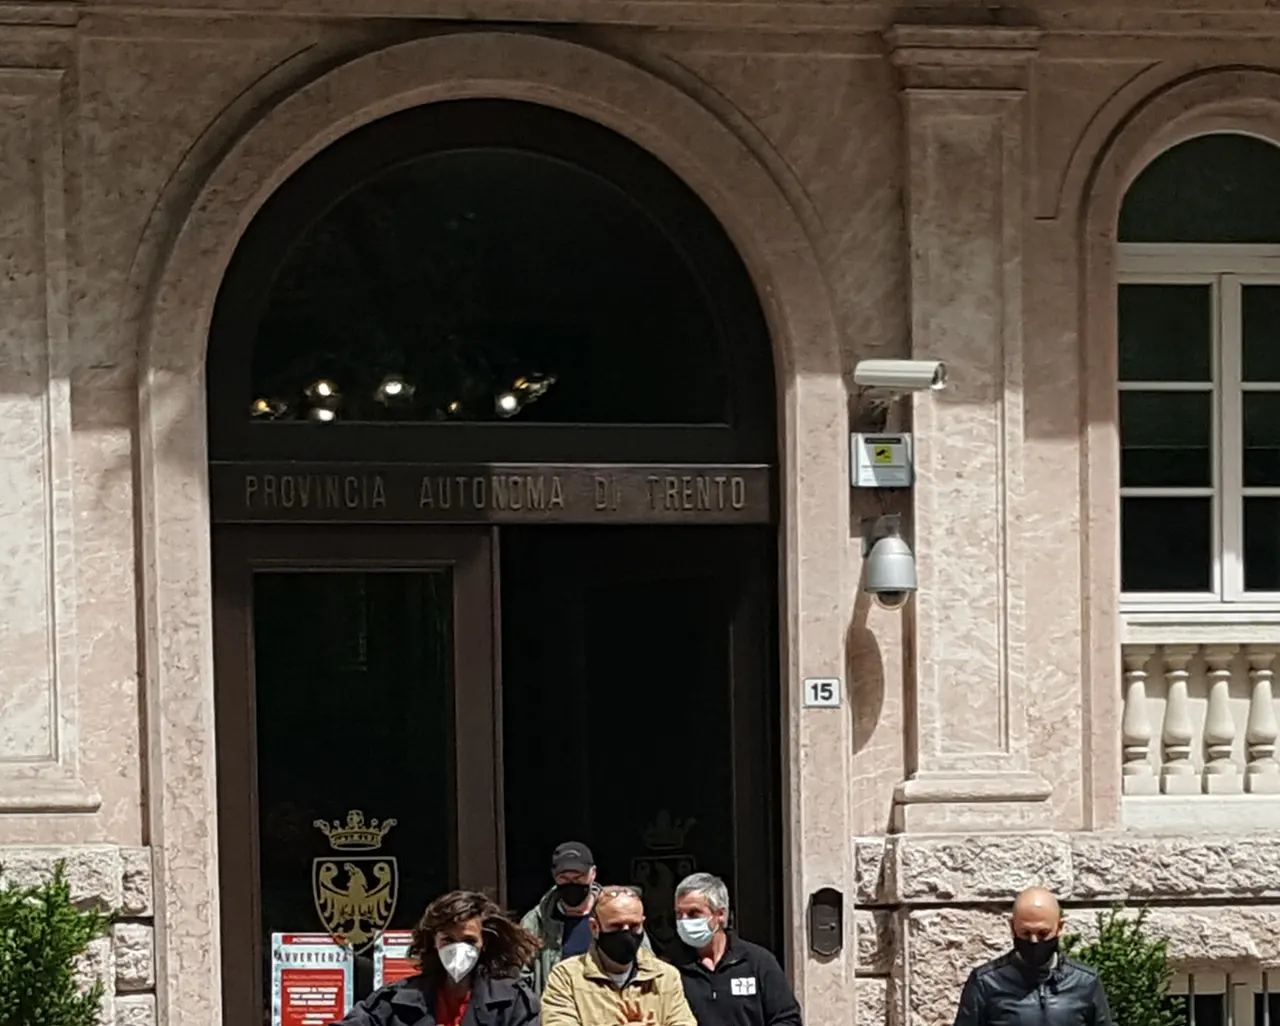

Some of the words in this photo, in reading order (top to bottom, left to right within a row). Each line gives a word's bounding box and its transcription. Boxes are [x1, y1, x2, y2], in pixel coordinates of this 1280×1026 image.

[244, 474, 387, 509] PROVINCIA
[419, 475, 564, 510] AUTONOMA
[594, 475, 617, 511] DI
[645, 474, 746, 511] TRENTO
[811, 683, 833, 701] 15
[276, 951, 349, 963] AVVERTENZA
